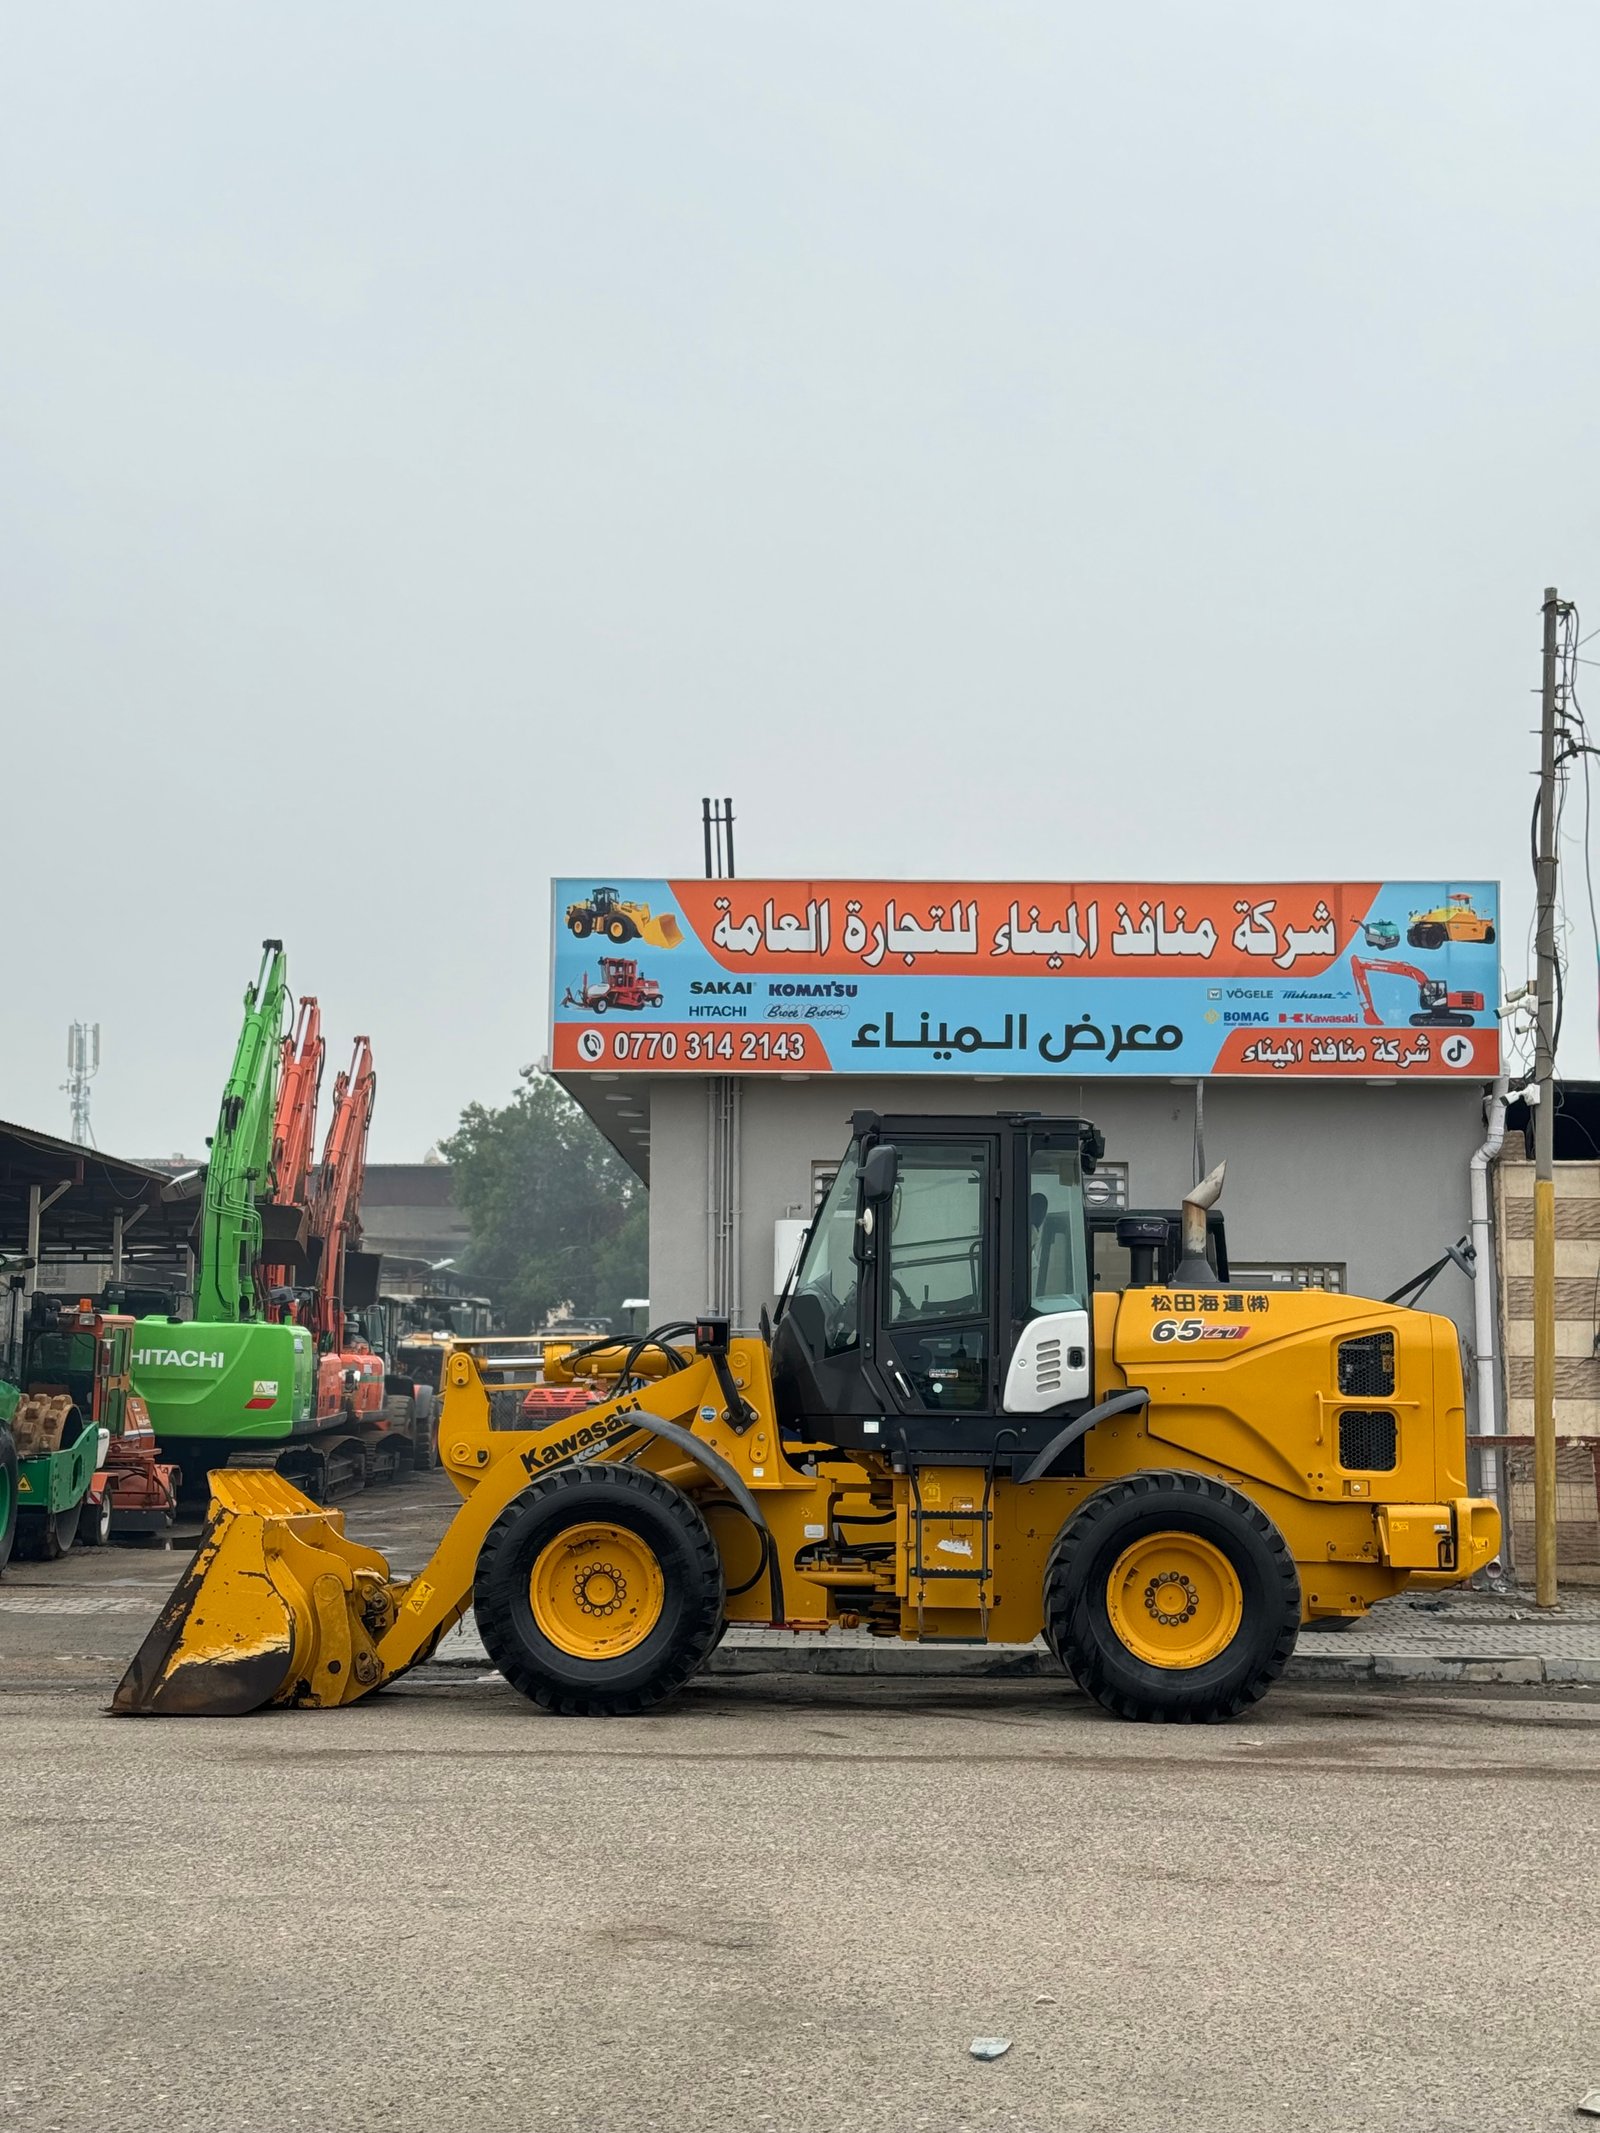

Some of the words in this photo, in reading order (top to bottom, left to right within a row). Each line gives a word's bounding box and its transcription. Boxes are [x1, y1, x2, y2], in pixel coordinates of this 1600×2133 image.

[712, 897, 832, 957] العامة
[843, 898, 979, 968] للتجارة
[989, 899, 1098, 970] الميناء
[1111, 900, 1219, 960] منافذ
[1232, 899, 1337, 970] شركة
[690, 981, 752, 995] SAKAI
[768, 981, 858, 998] KOMATSU
[1226, 988, 1274, 999] VÖGELE
[689, 1005, 747, 1017] HITACHI
[804, 1005, 847, 1019] Broom
[1223, 1011, 1270, 1022] BOMAG
[1305, 1013, 1359, 1024] Kawasaki
[613, 1032, 678, 1061] 0770
[685, 1032, 734, 1061] 314
[740, 1032, 805, 1061] 2143
[851, 1011, 1028, 1060] الميناء
[1038, 1013, 1184, 1063] معرض
[1309, 1036, 1367, 1063] منافذ
[1241, 1037, 1304, 1069] الميناء
[1371, 1033, 1431, 1069] شركة
[131, 1348, 224, 1368] HITACHI
